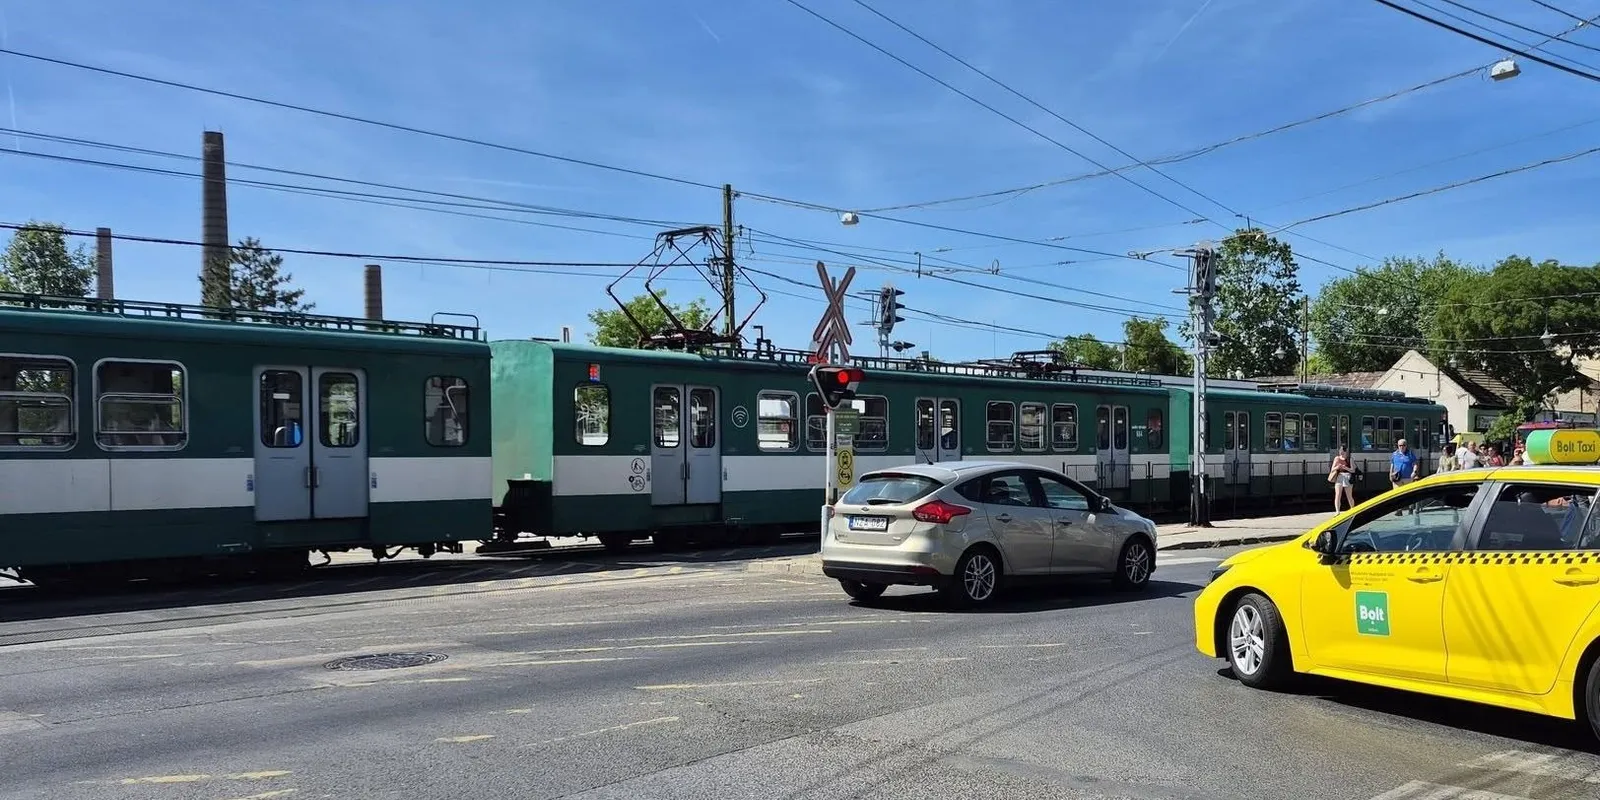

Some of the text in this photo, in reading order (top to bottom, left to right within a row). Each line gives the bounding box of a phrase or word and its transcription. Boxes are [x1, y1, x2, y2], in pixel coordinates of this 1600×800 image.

[1557, 440, 1596, 453] Bolt Taxi
[1359, 605, 1385, 622] Bolt
